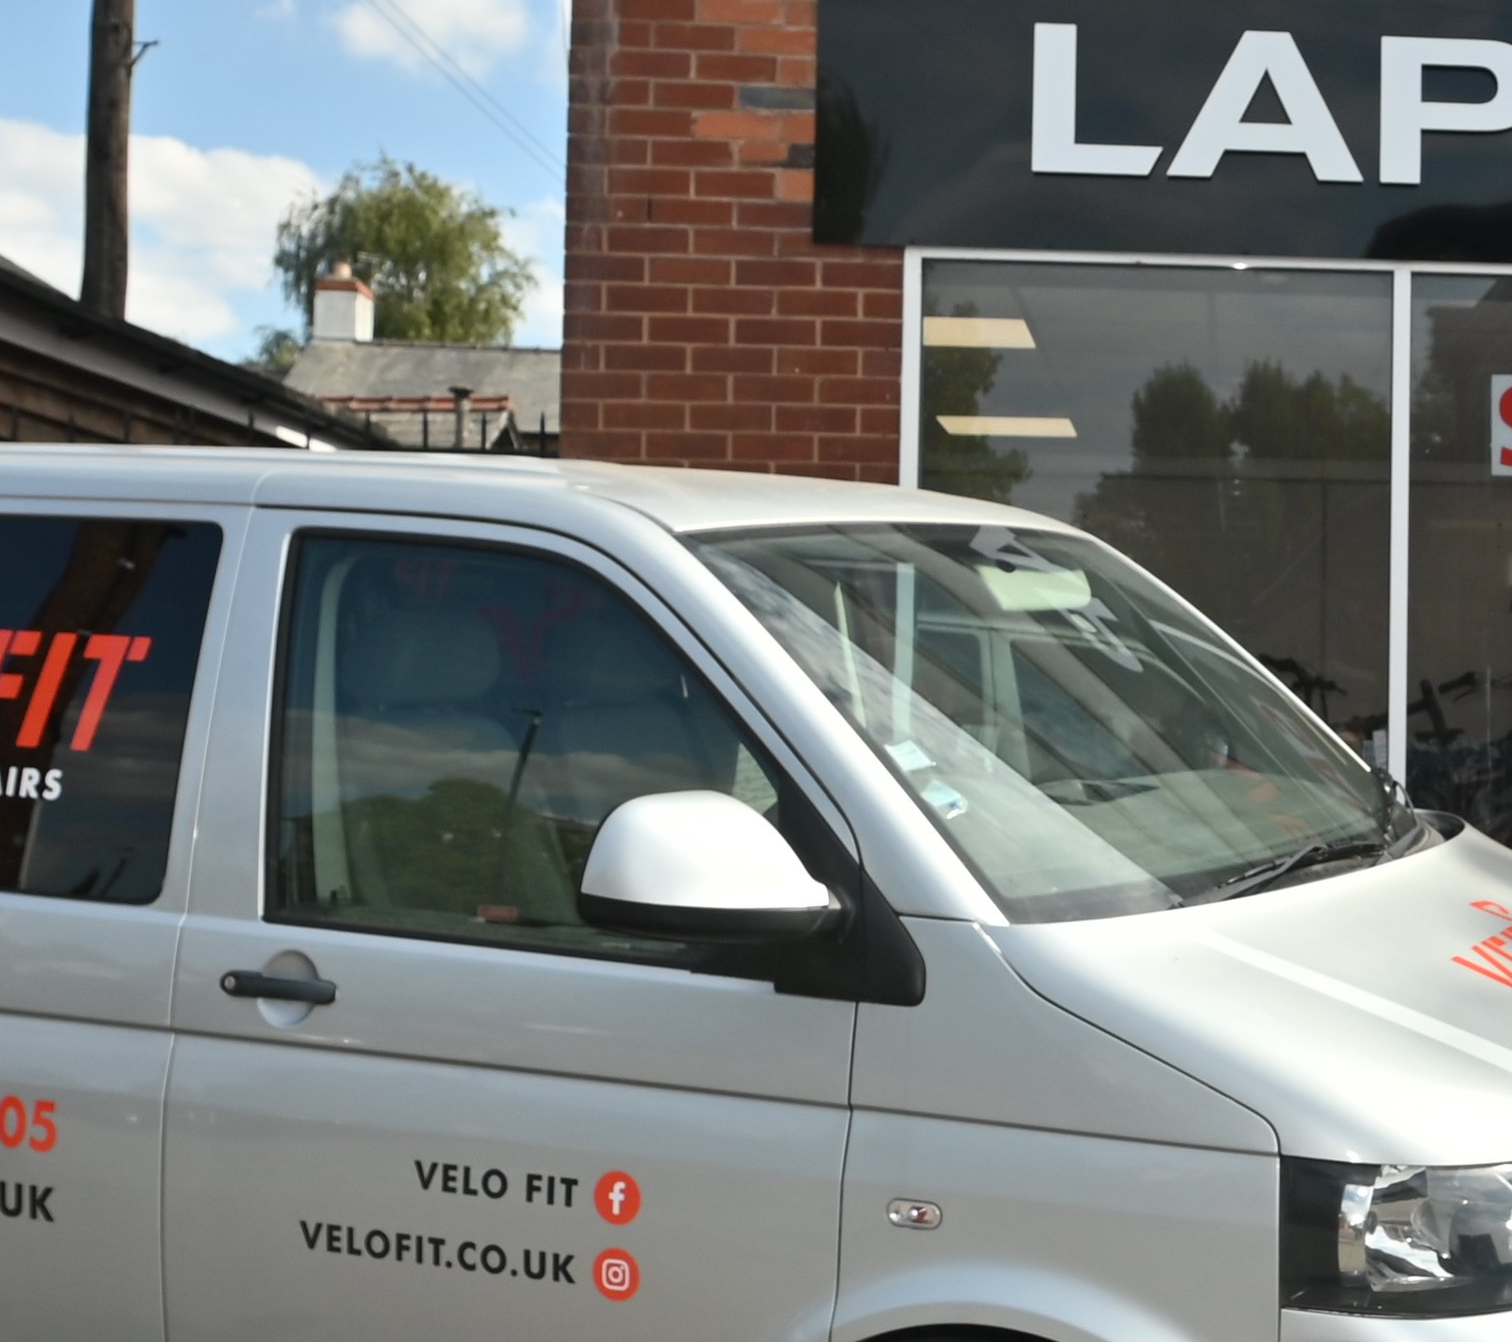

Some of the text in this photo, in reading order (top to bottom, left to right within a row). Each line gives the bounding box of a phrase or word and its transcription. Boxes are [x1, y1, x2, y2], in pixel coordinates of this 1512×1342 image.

[414, 1159, 508, 1199] VELO
[525, 1173, 578, 1208] FIT
[299, 1220, 576, 1285] VELOFIT.CO.UK
